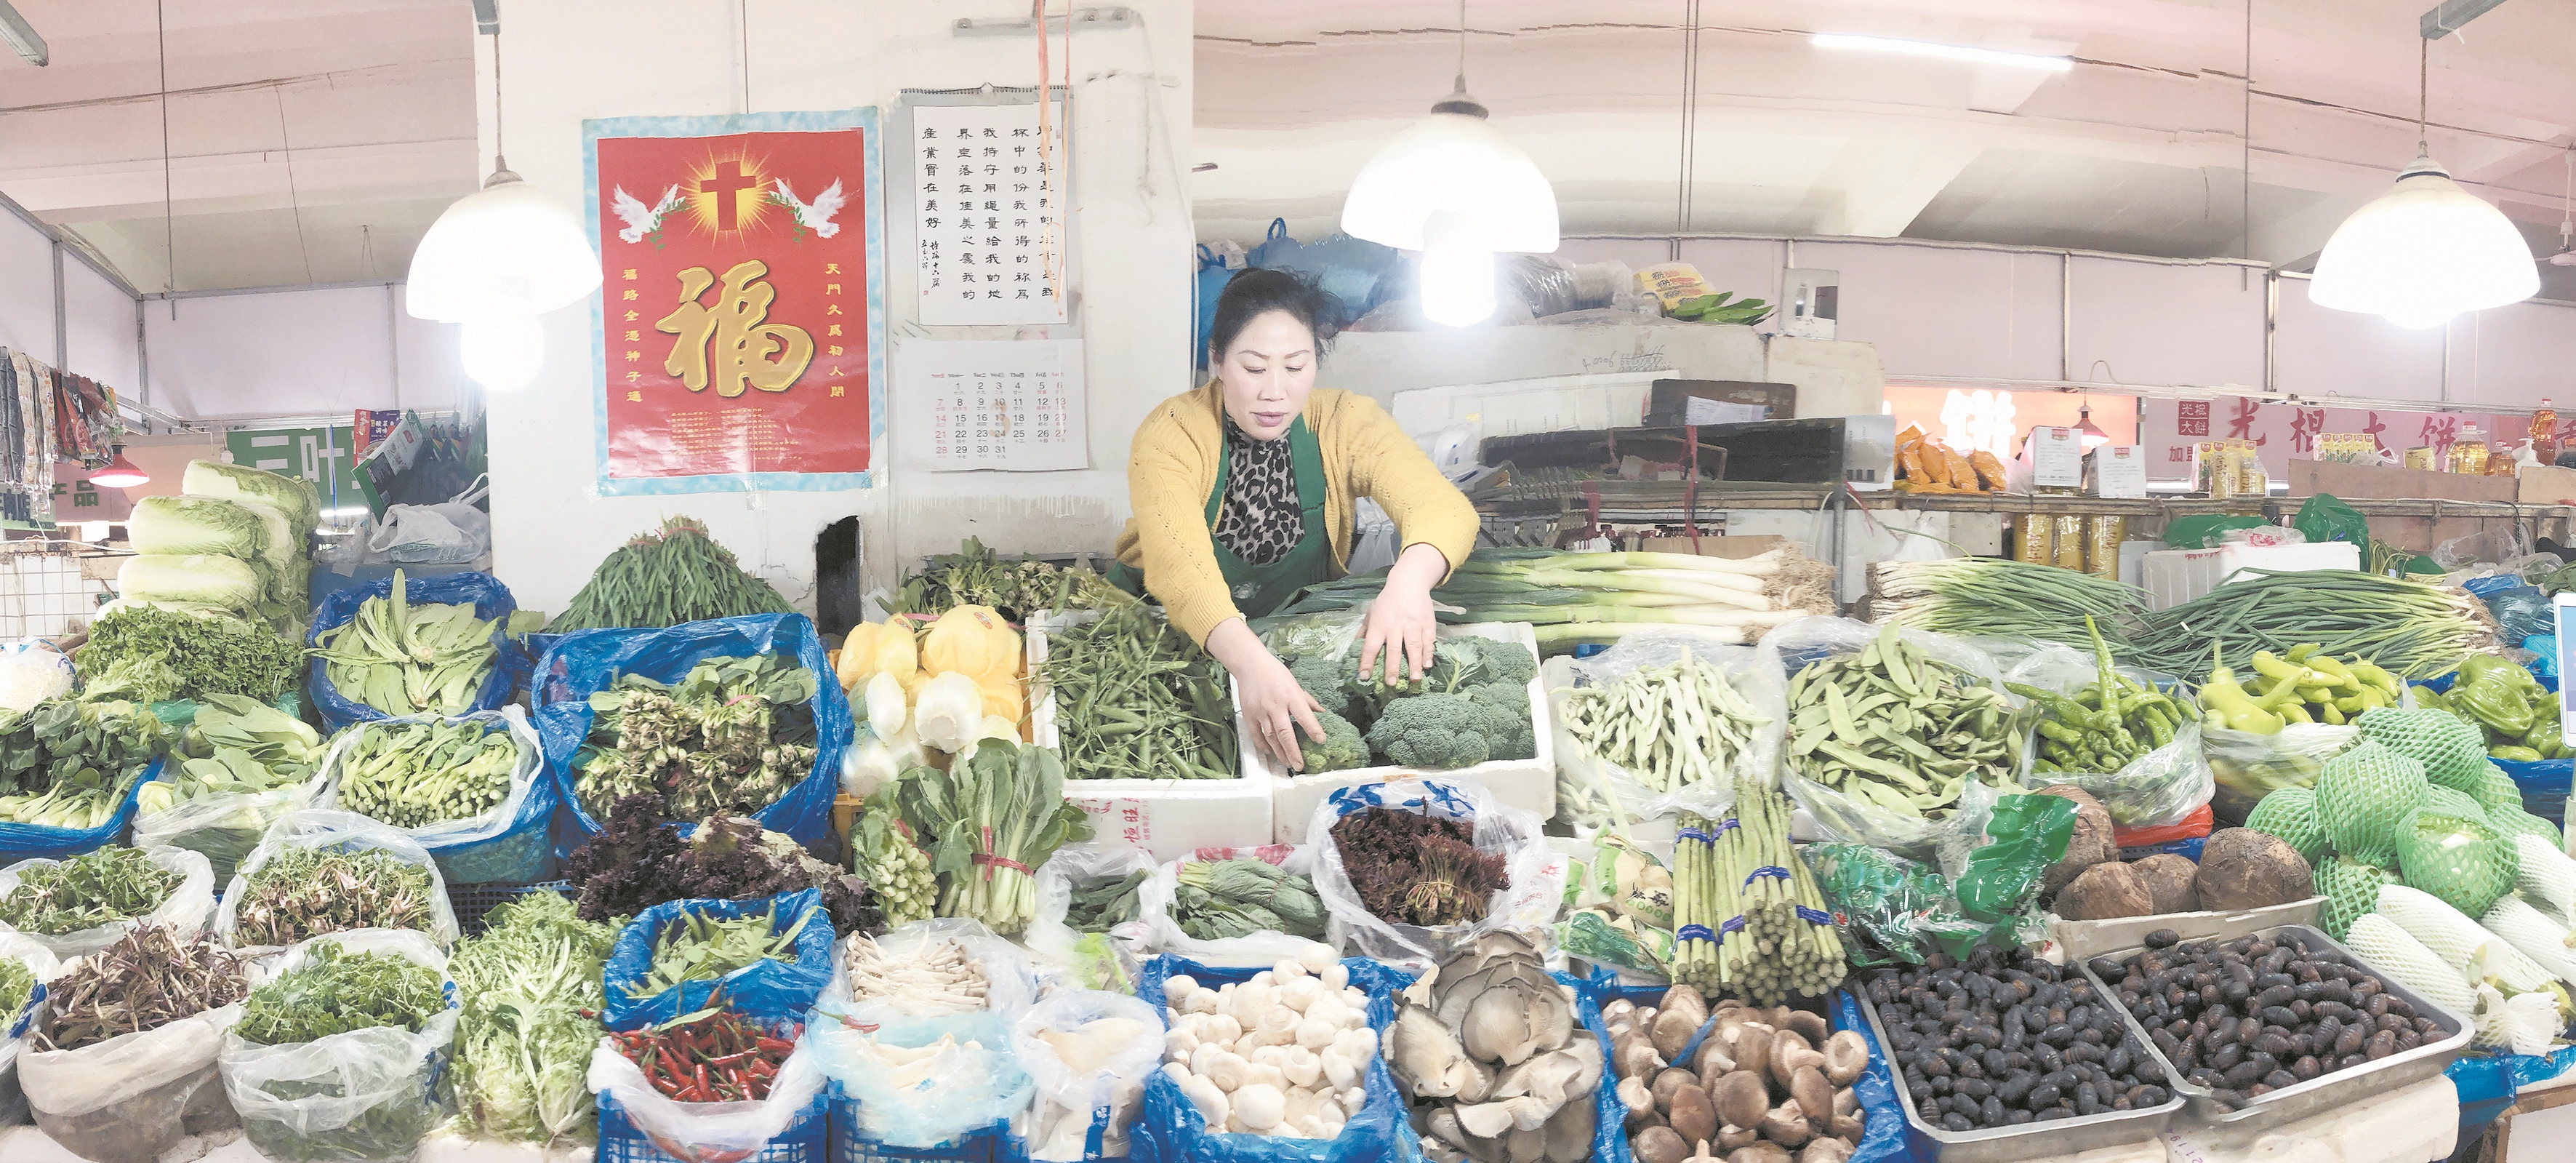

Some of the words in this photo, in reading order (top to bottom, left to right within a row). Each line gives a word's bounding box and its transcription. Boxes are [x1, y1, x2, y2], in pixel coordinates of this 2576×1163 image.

[655, 260, 814, 397] 福
[977, 382, 984, 390] 2
[995, 382, 1002, 390] 3
[938, 399, 944, 407] 7
[957, 398, 963, 406] 8
[995, 398, 1006, 406] 10
[1055, 397, 1066, 405] 13
[2181, 404, 2207, 415] 光棍
[1038, 413, 1048, 421] 19
[1055, 413, 1067, 421] 20
[955, 430, 967, 438] 22
[976, 429, 988, 437] 23
[1013, 430, 1025, 438] 25
[1055, 429, 1067, 437] 27
[976, 445, 989, 453] 30
[251, 428, 361, 496] 三叶
